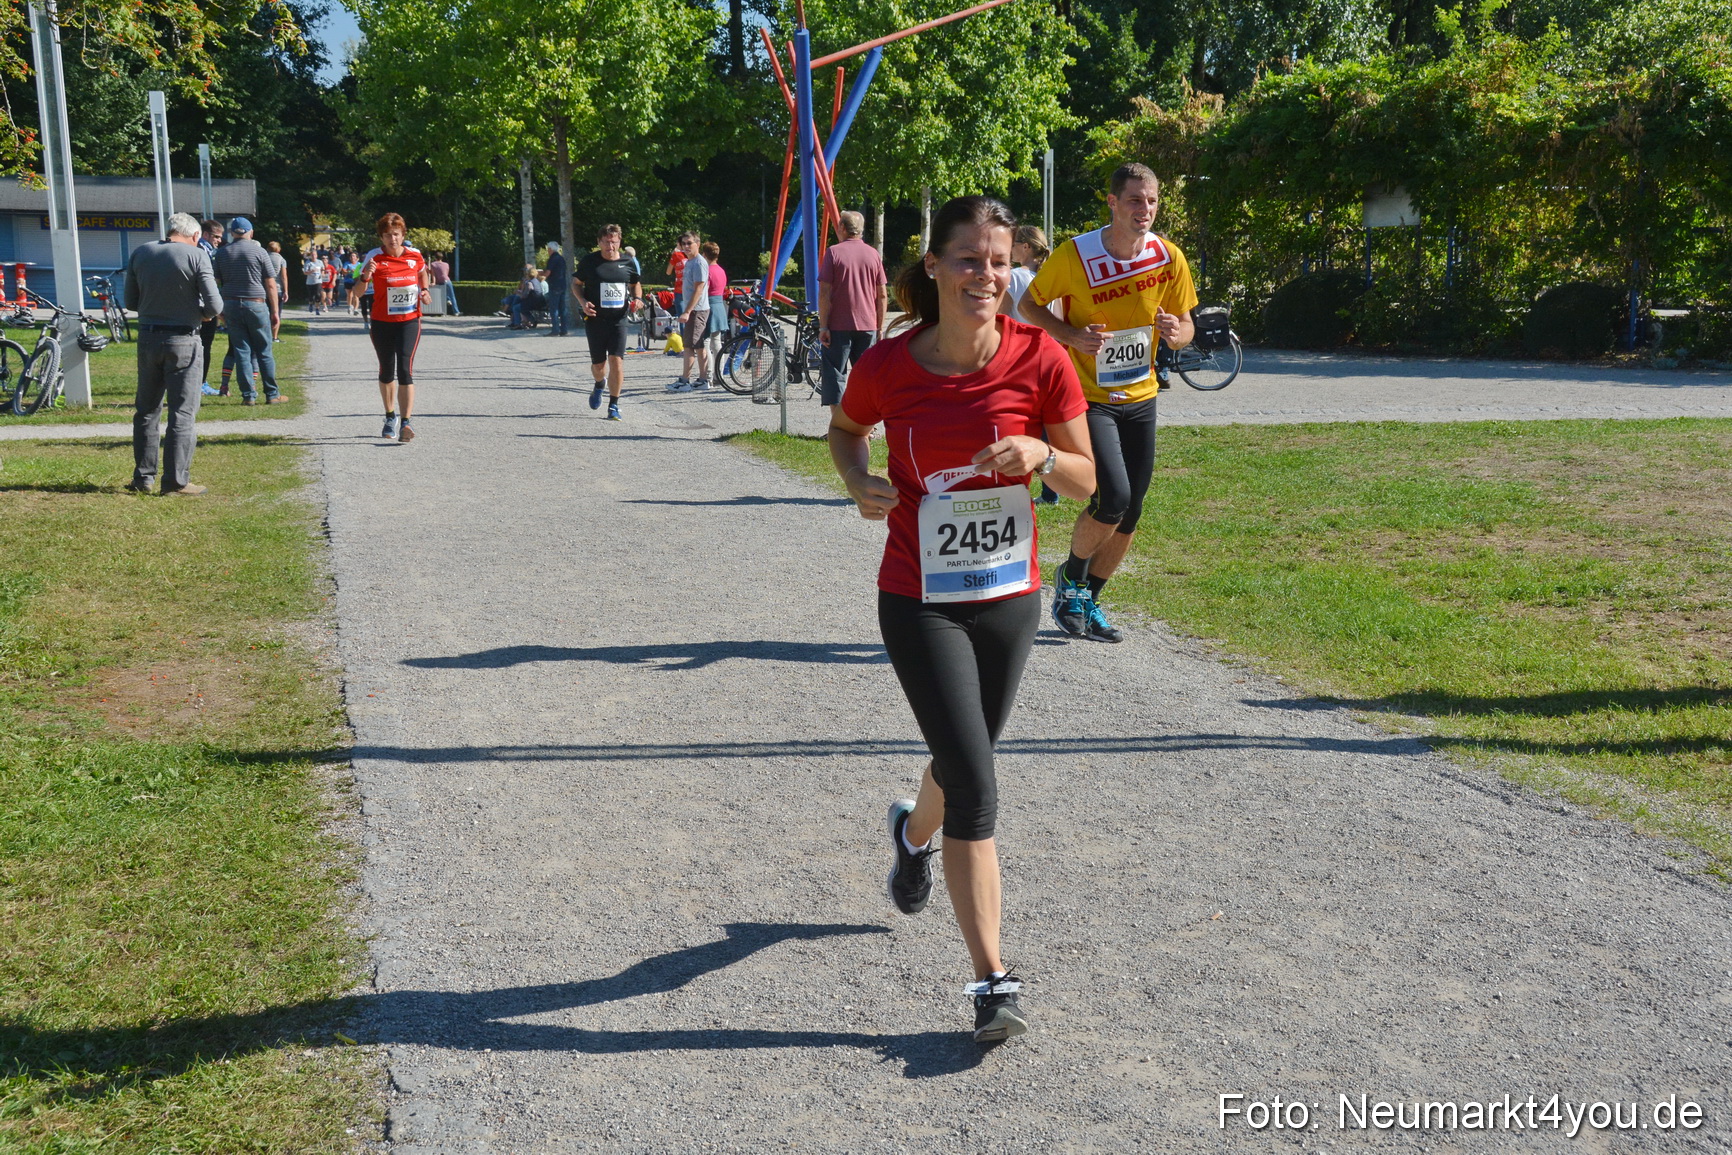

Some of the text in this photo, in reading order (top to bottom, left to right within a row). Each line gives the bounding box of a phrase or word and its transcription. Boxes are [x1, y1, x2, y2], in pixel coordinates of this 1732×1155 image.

[76, 217, 106, 227] CAFE
[1092, 270, 1174, 305] MAX BÖGL
[392, 293, 413, 303] 2247
[1105, 343, 1144, 364] 2400
[1113, 370, 1139, 381] Michael
[953, 497, 1001, 513] BOCK
[937, 516, 1017, 557] 2454
[963, 571, 997, 588] Steffi
